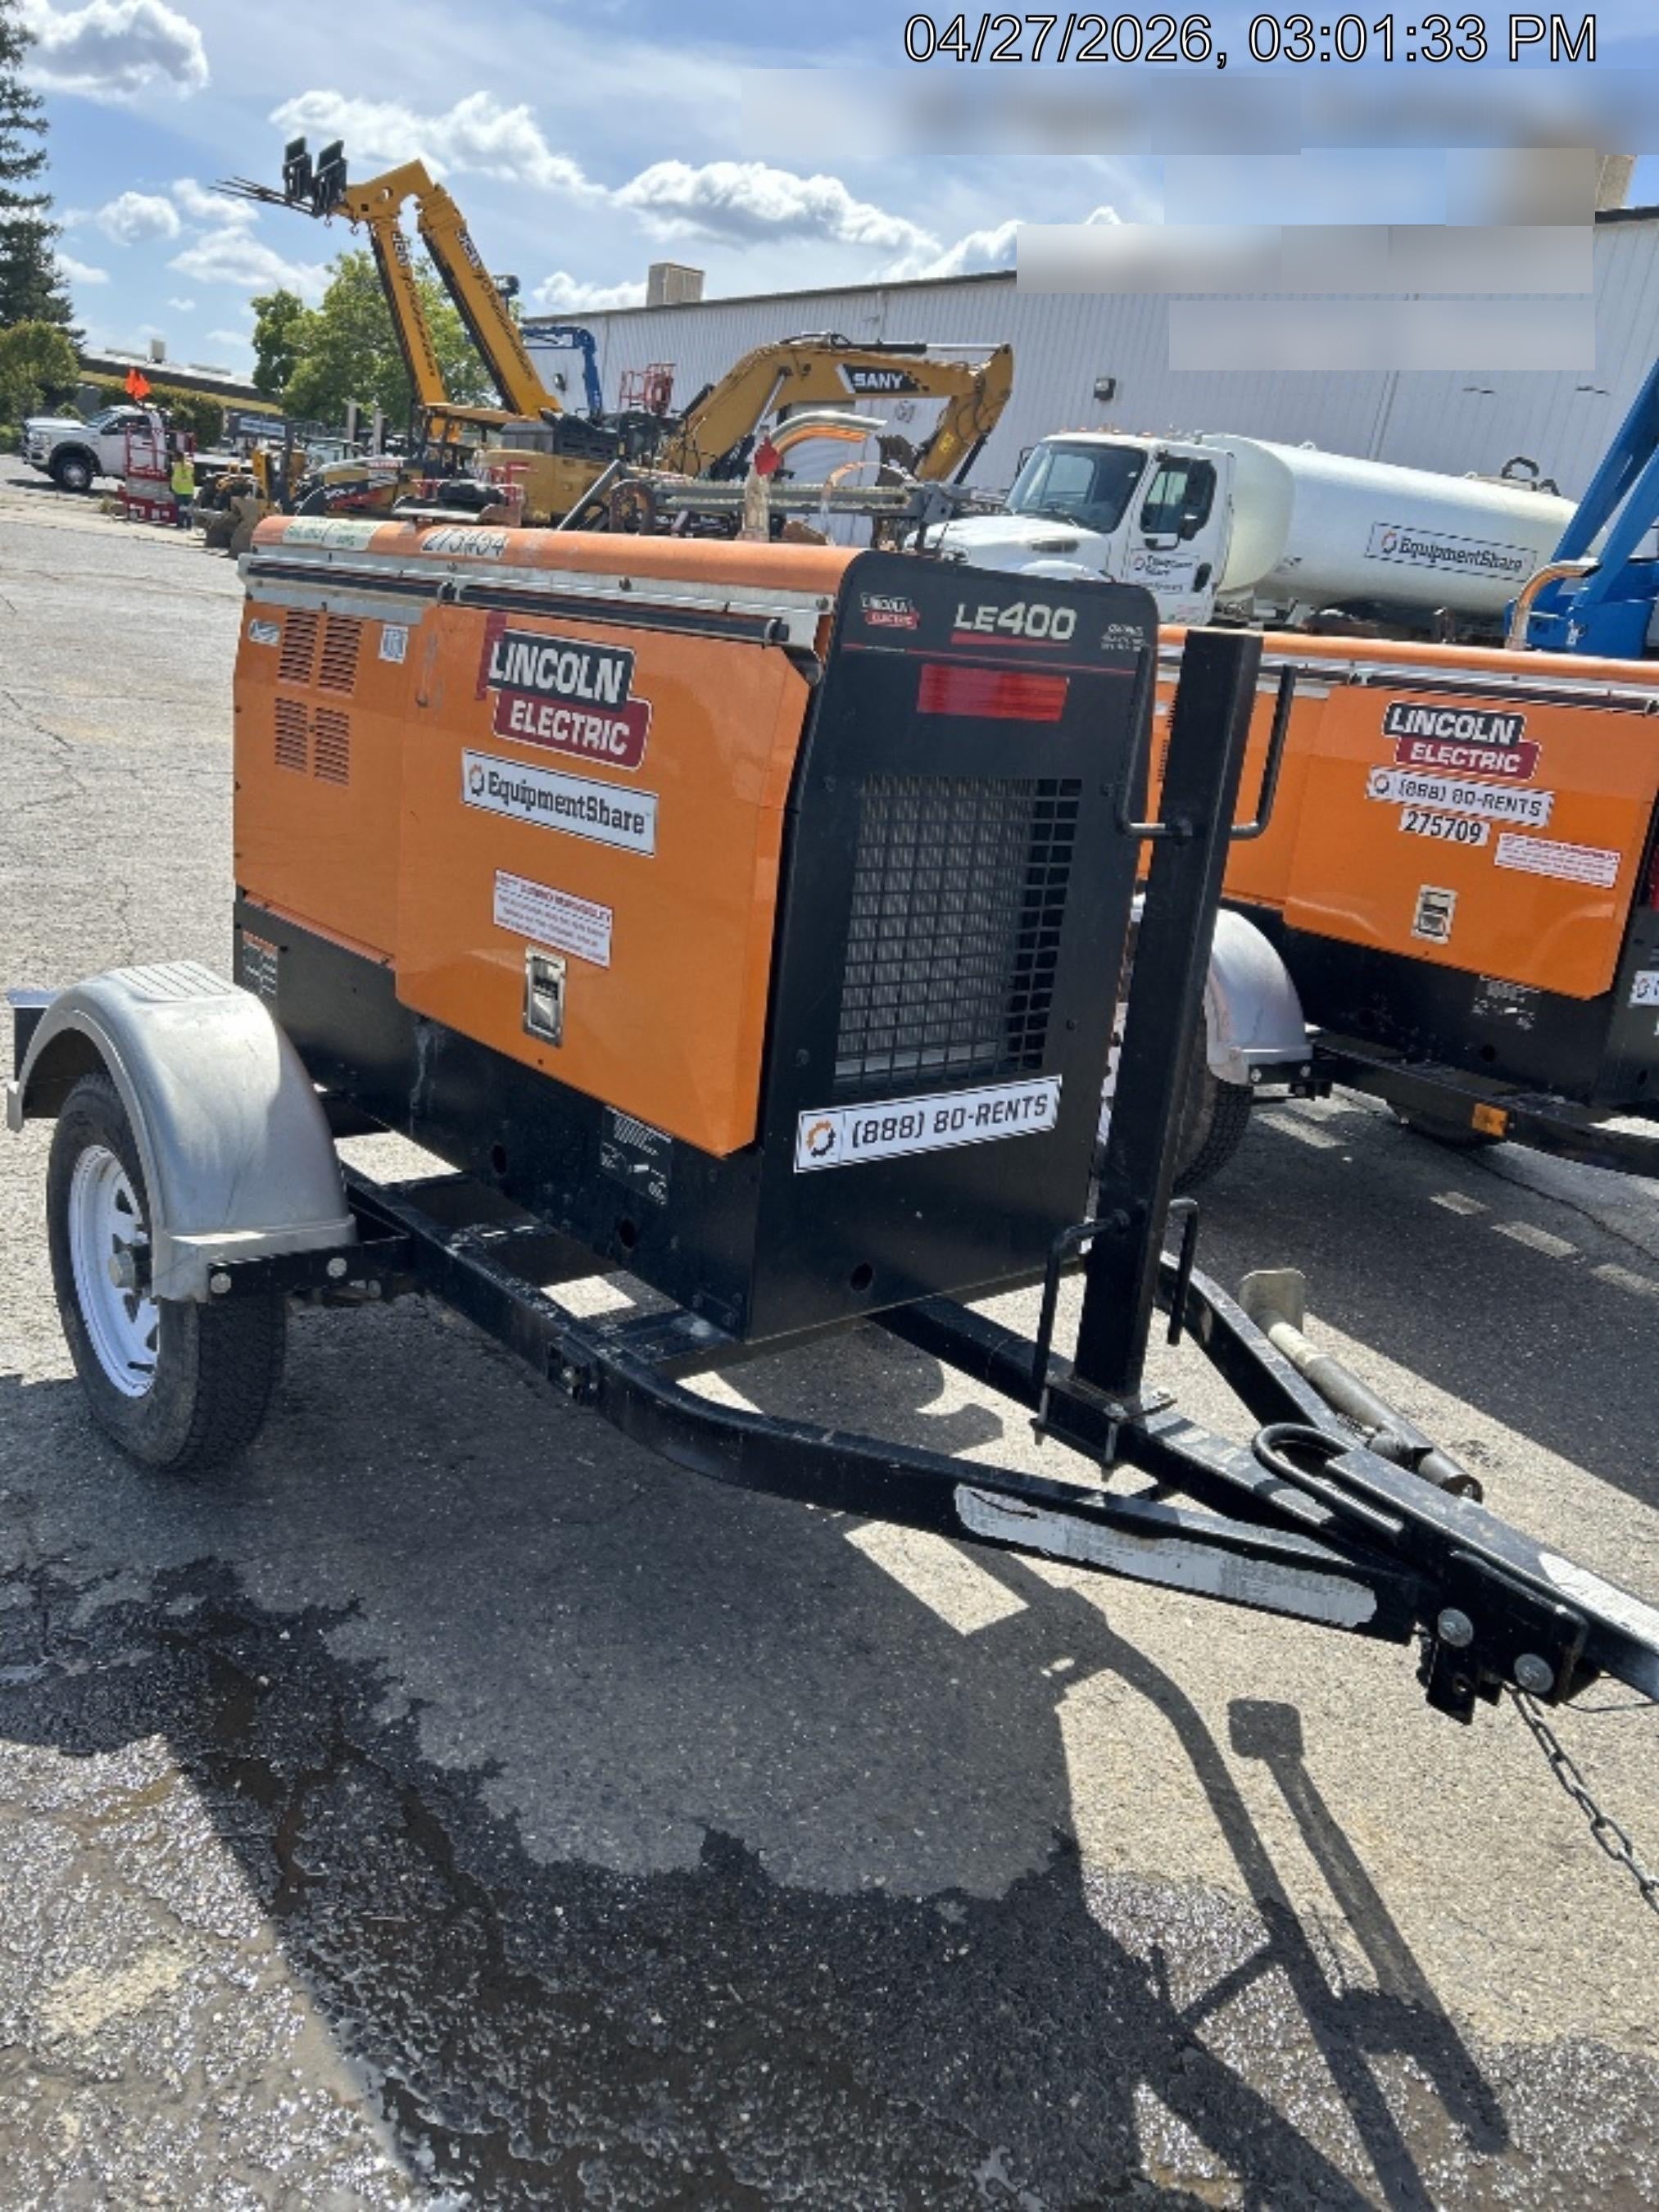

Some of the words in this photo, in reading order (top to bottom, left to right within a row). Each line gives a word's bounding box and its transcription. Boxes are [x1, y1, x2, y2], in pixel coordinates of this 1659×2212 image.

[854, 373, 902, 389] SANY
[1399, 537, 1522, 573] EquipmentShare
[953, 602, 1077, 640] LE400
[488, 641, 624, 704] LINCOLN
[509, 700, 630, 756] ELECTRIC
[1390, 707, 1516, 744] LINCOLN
[1410, 741, 1521, 773] ELECTRIC
[488, 771, 646, 835] EquipmentShare
[1404, 811, 1483, 844] 275709
[851, 1111, 926, 1148] (888)
